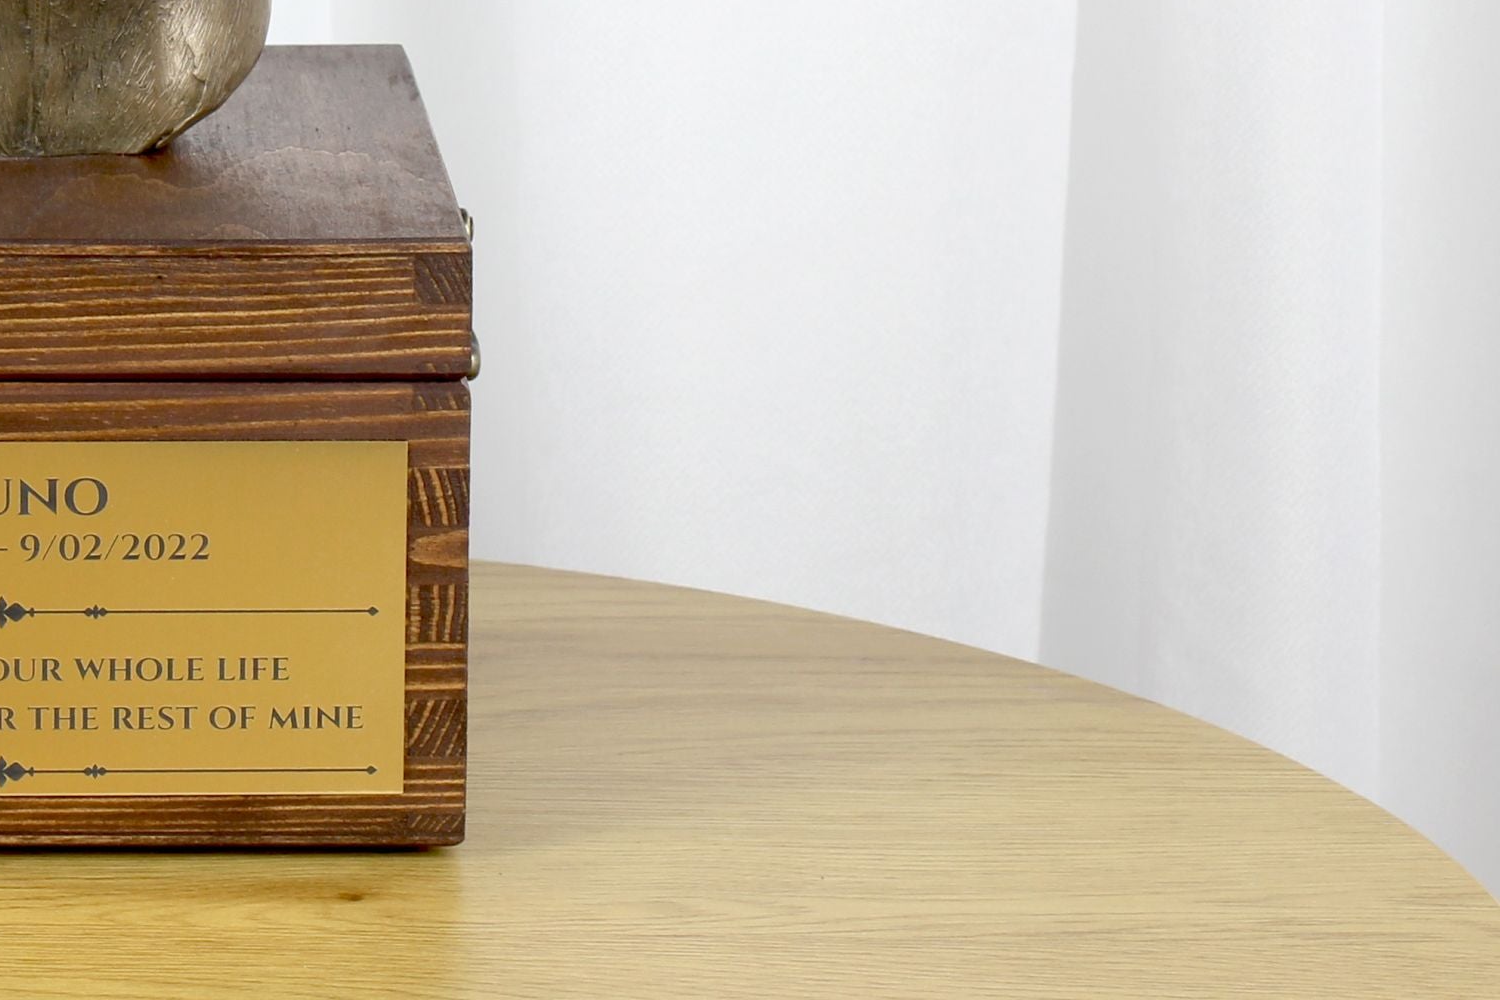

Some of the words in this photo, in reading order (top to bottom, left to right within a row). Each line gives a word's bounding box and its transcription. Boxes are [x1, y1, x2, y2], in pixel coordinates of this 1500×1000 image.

[19, 533, 211, 562] 9/02/2022
[74, 656, 205, 683] WHOLE
[217, 656, 290, 682] LIFE
[27, 705, 100, 731] THE
[112, 705, 199, 732] REST
[208, 705, 257, 731] OF
[268, 704, 364, 730] MINE
